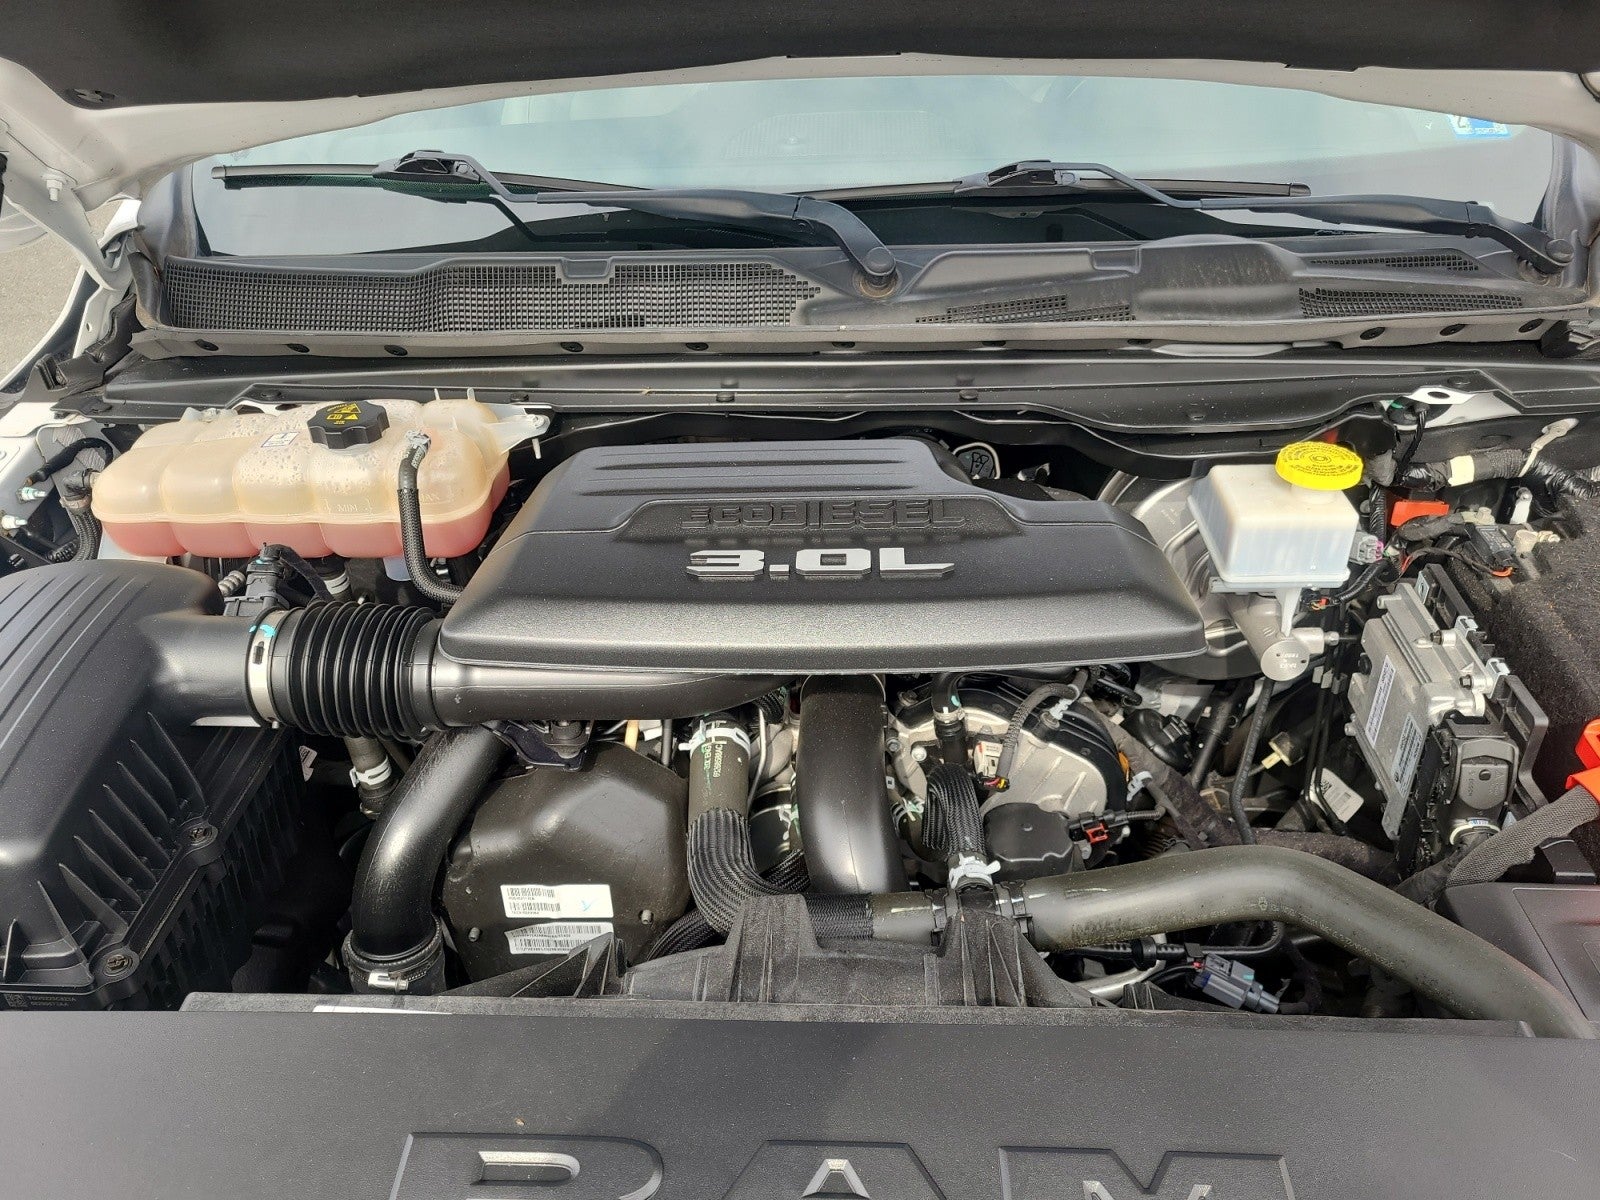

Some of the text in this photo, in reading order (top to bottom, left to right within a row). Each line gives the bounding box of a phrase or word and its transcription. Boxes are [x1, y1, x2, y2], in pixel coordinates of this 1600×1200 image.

[681, 500, 966, 529] ECODIESEL
[686, 547, 955, 578] 3.0L
[389, 1132, 1296, 1200] RAM
